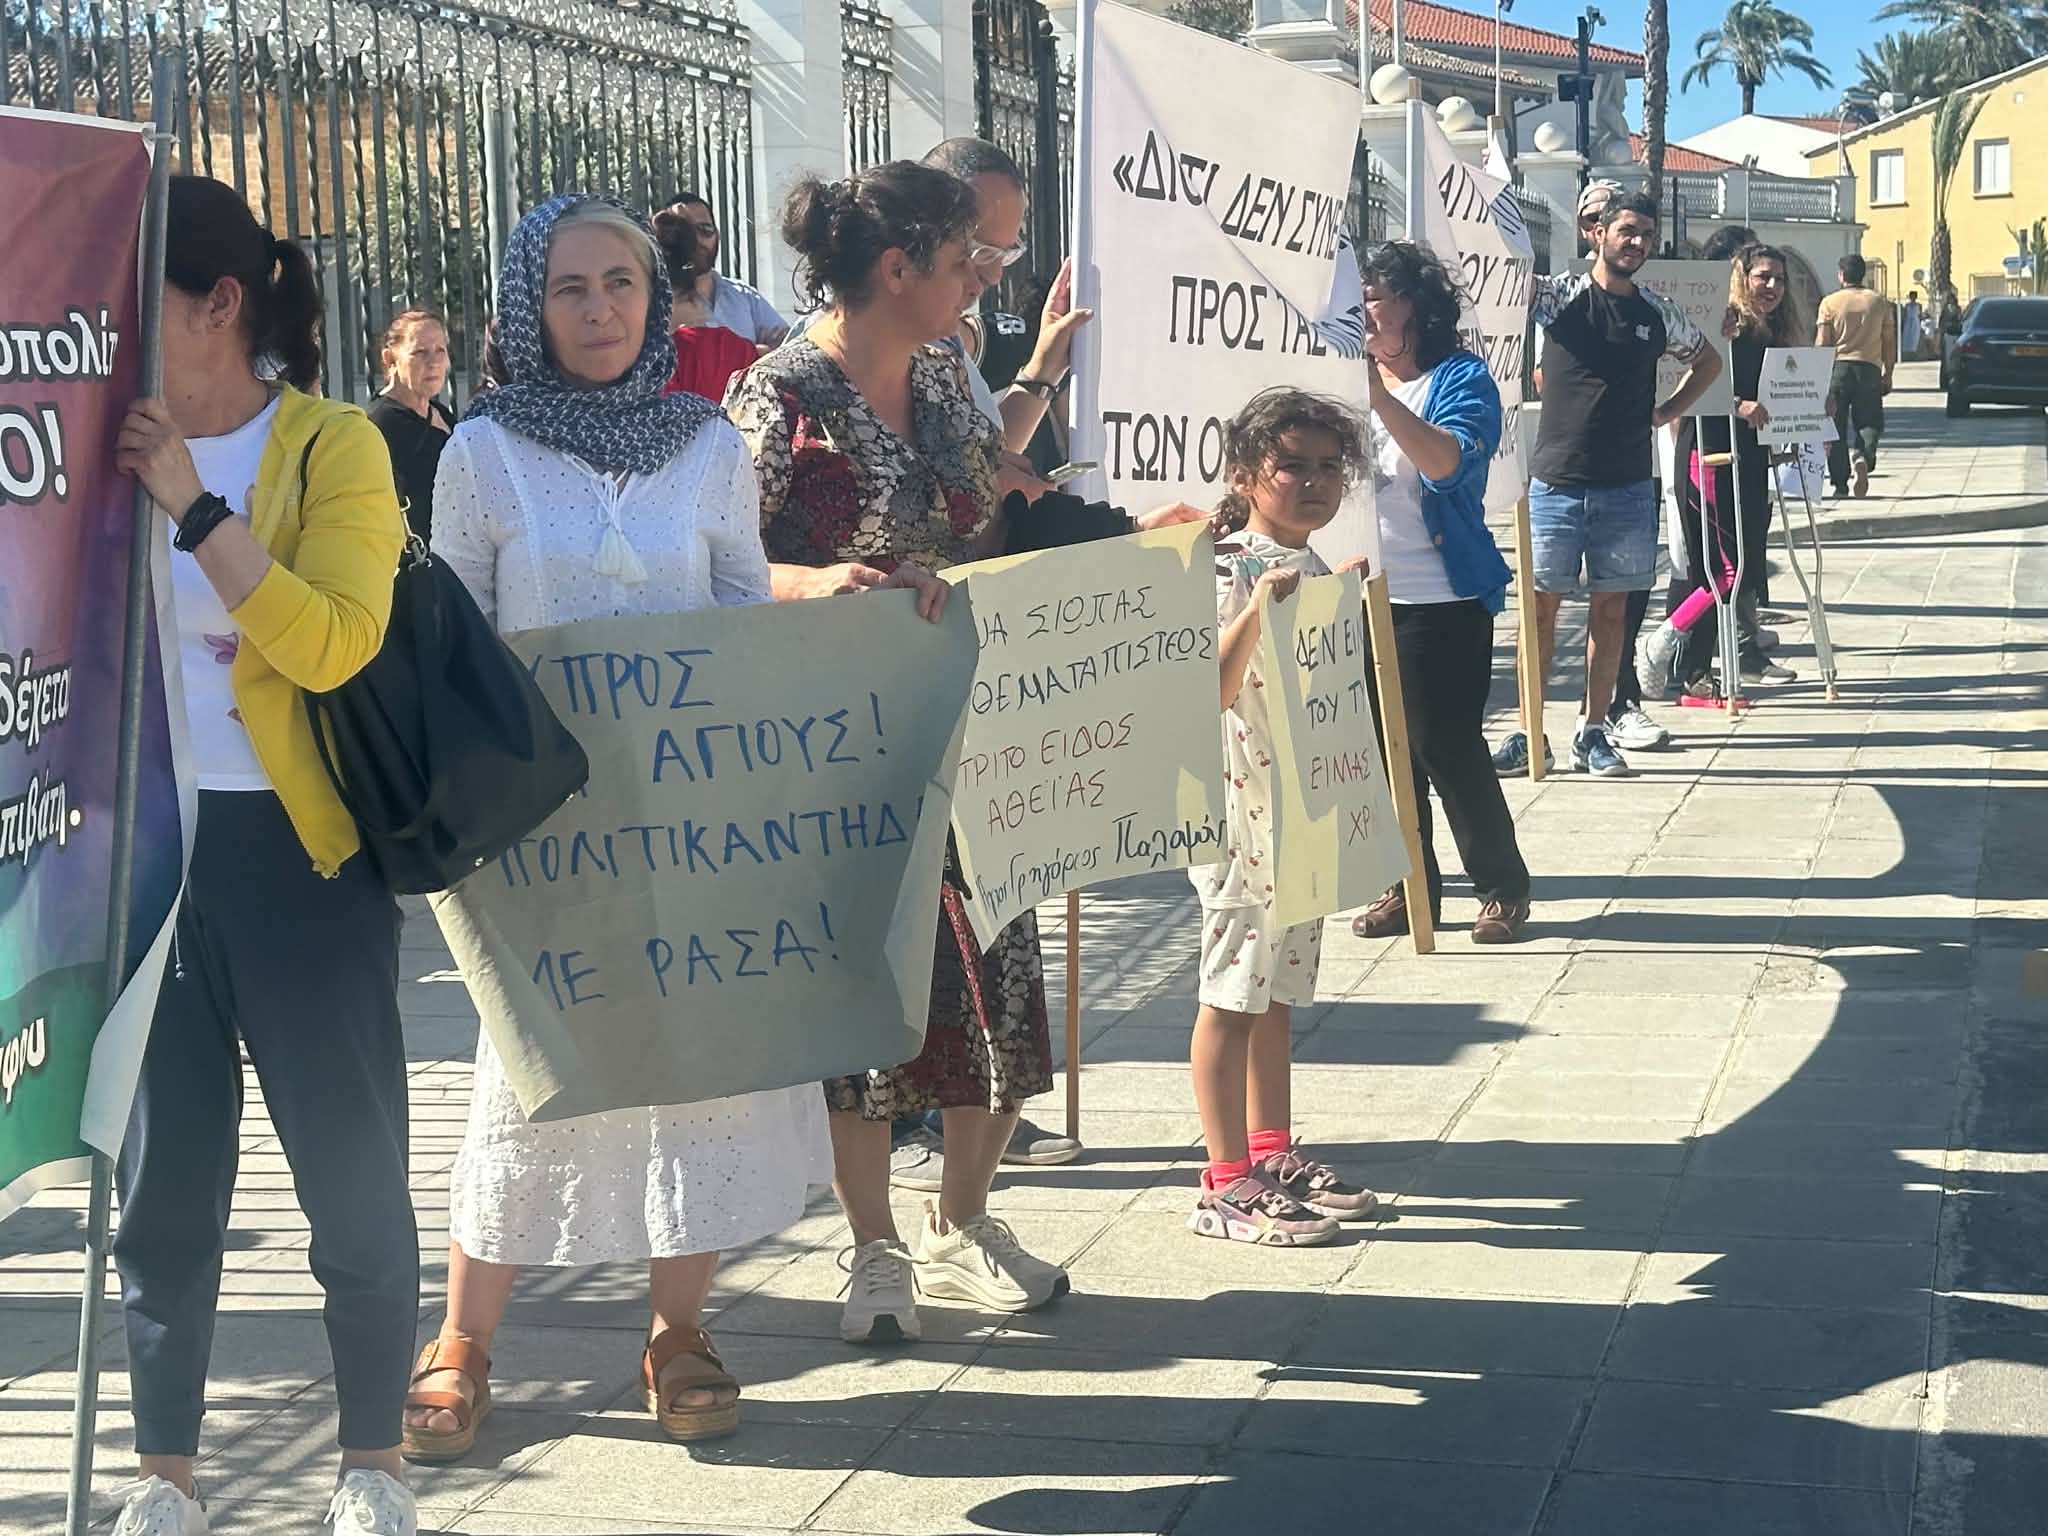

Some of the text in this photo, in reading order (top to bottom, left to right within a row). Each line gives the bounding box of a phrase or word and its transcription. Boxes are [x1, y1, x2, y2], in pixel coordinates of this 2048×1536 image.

[1221, 172, 1295, 246] ΔΕΝ
[1169, 276, 1267, 351] ΠΡΟΣ
[1458, 252, 1499, 304] ΟΥ
[1103, 411, 1188, 482] ΤΩΝ
[1295, 623, 1336, 672] ΔΕΝ
[652, 692, 887, 784] ΑΓΙΟΥΣ!
[1306, 692, 1339, 729] ΤΟΥ
[959, 712, 1135, 790] ΤΡΙΤΟ ΕΙΔΟΣ
[502, 795, 924, 887] ΠΟΛΙΤΙΚΑΝΤΗΔ
[646, 902, 840, 997] ΡΑΣΑ!
